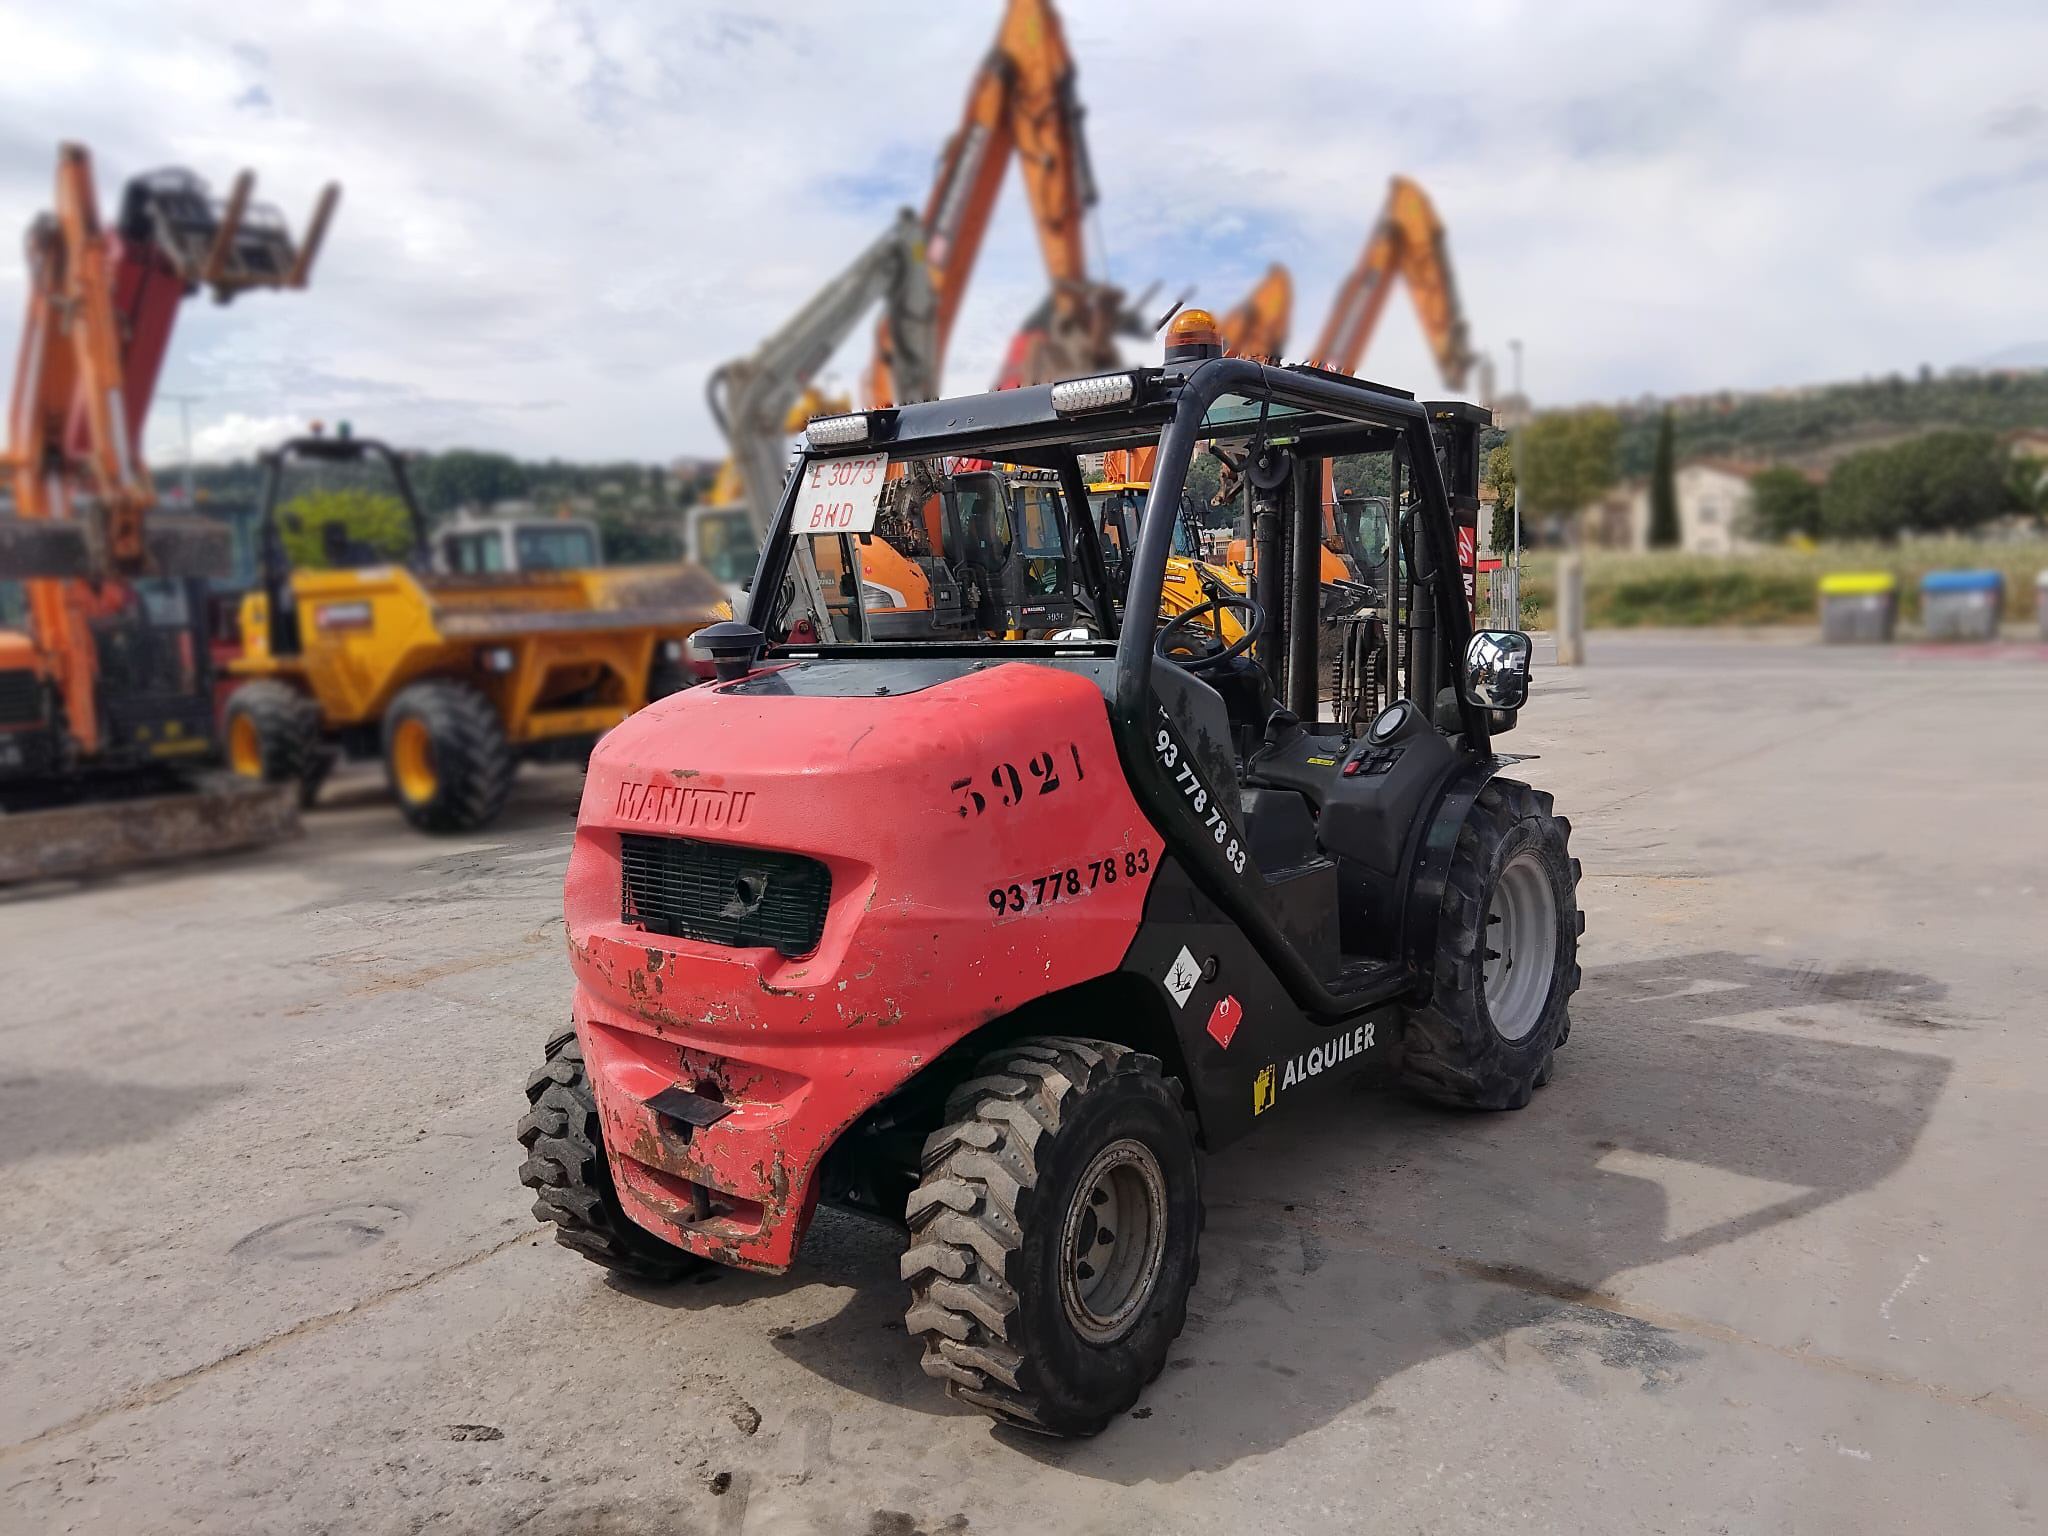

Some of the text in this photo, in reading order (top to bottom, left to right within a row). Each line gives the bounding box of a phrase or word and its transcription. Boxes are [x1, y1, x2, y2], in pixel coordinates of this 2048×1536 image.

[812, 460, 877, 489] E 3073
[615, 781, 756, 831] MANITOU
[951, 743, 1084, 818] 3921
[1155, 730, 1246, 873] 93 778 78 83
[988, 848, 1150, 916] 93 778 78 83
[1281, 1021, 1376, 1091] ALQUILER
